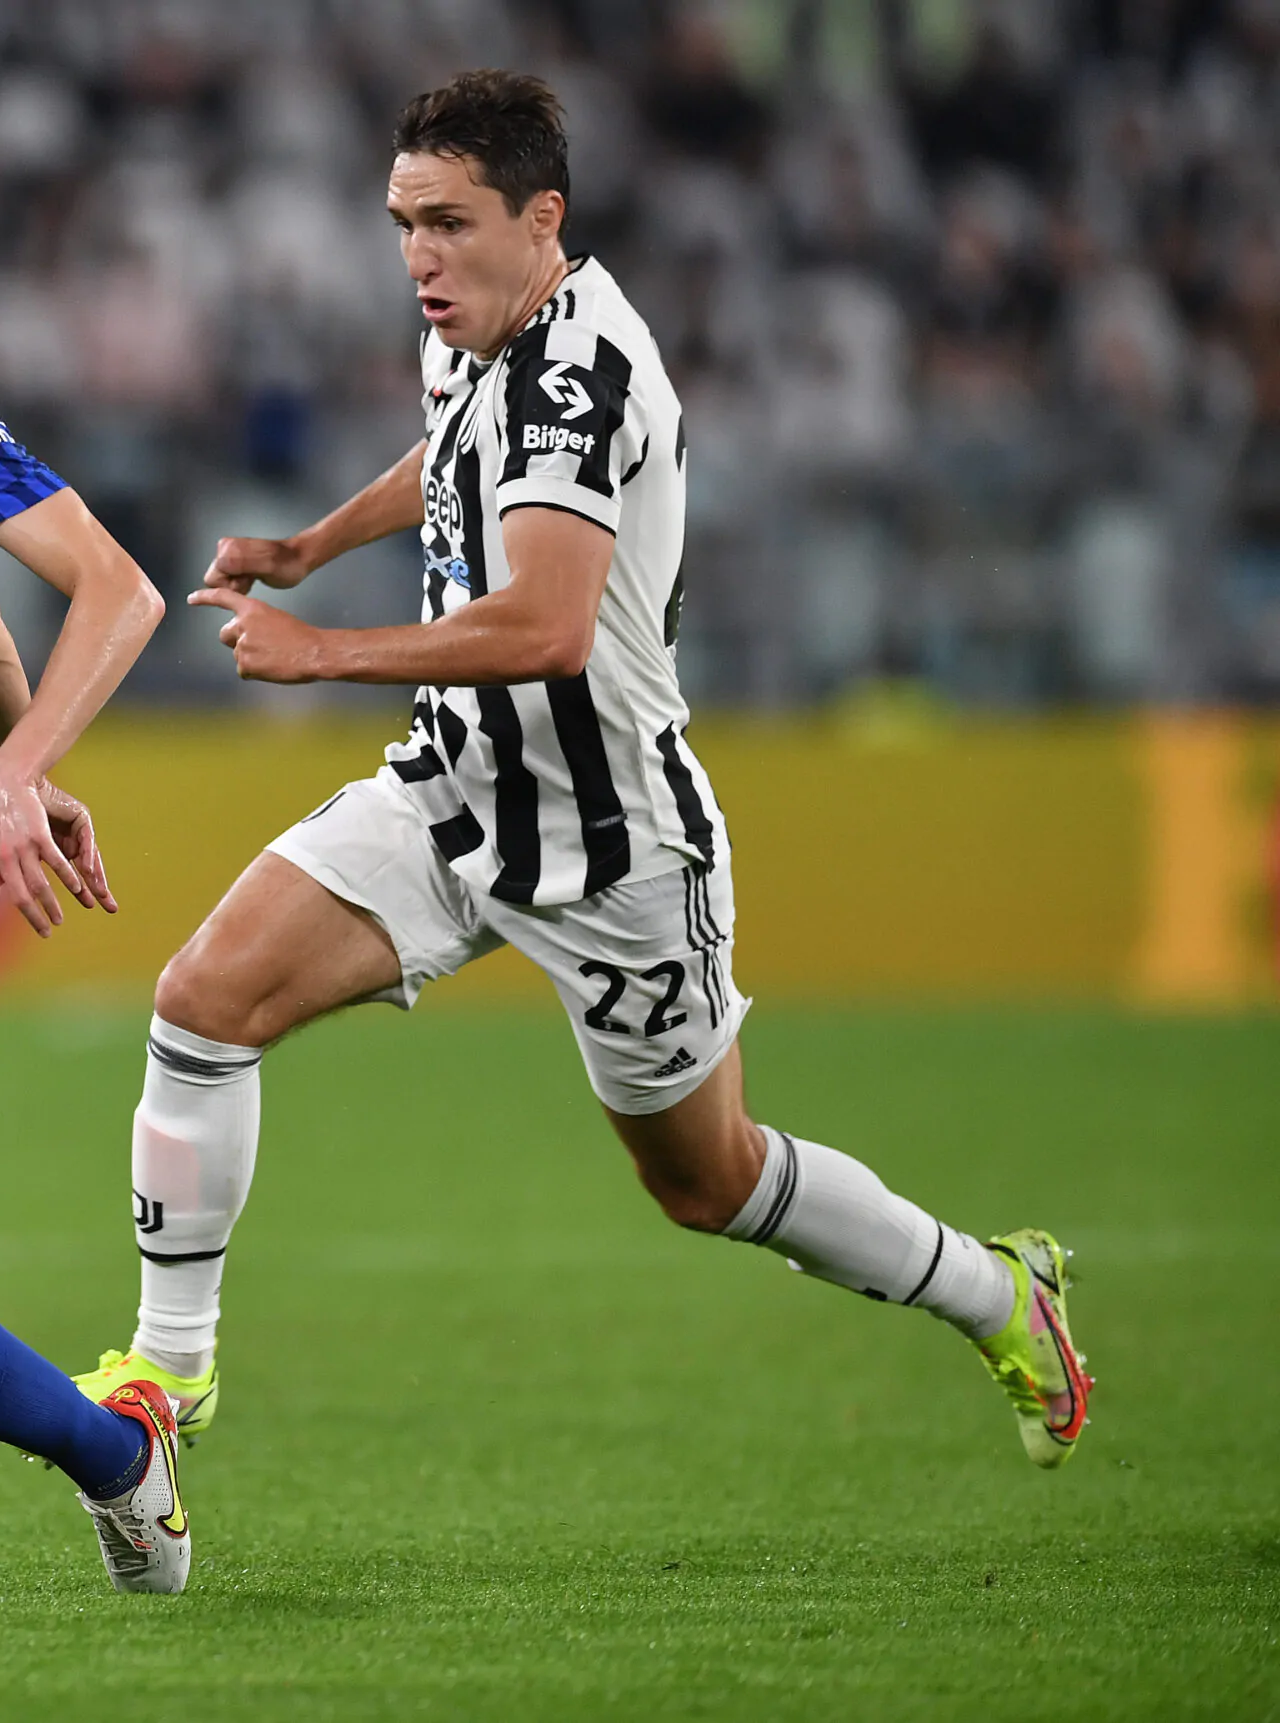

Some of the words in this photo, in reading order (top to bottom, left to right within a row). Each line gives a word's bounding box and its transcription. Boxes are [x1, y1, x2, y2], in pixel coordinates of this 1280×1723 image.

[522, 424, 595, 455] Bitget
[424, 547, 472, 589] xe
[578, 960, 687, 1037] 22
[654, 1057, 698, 1078] adidas
